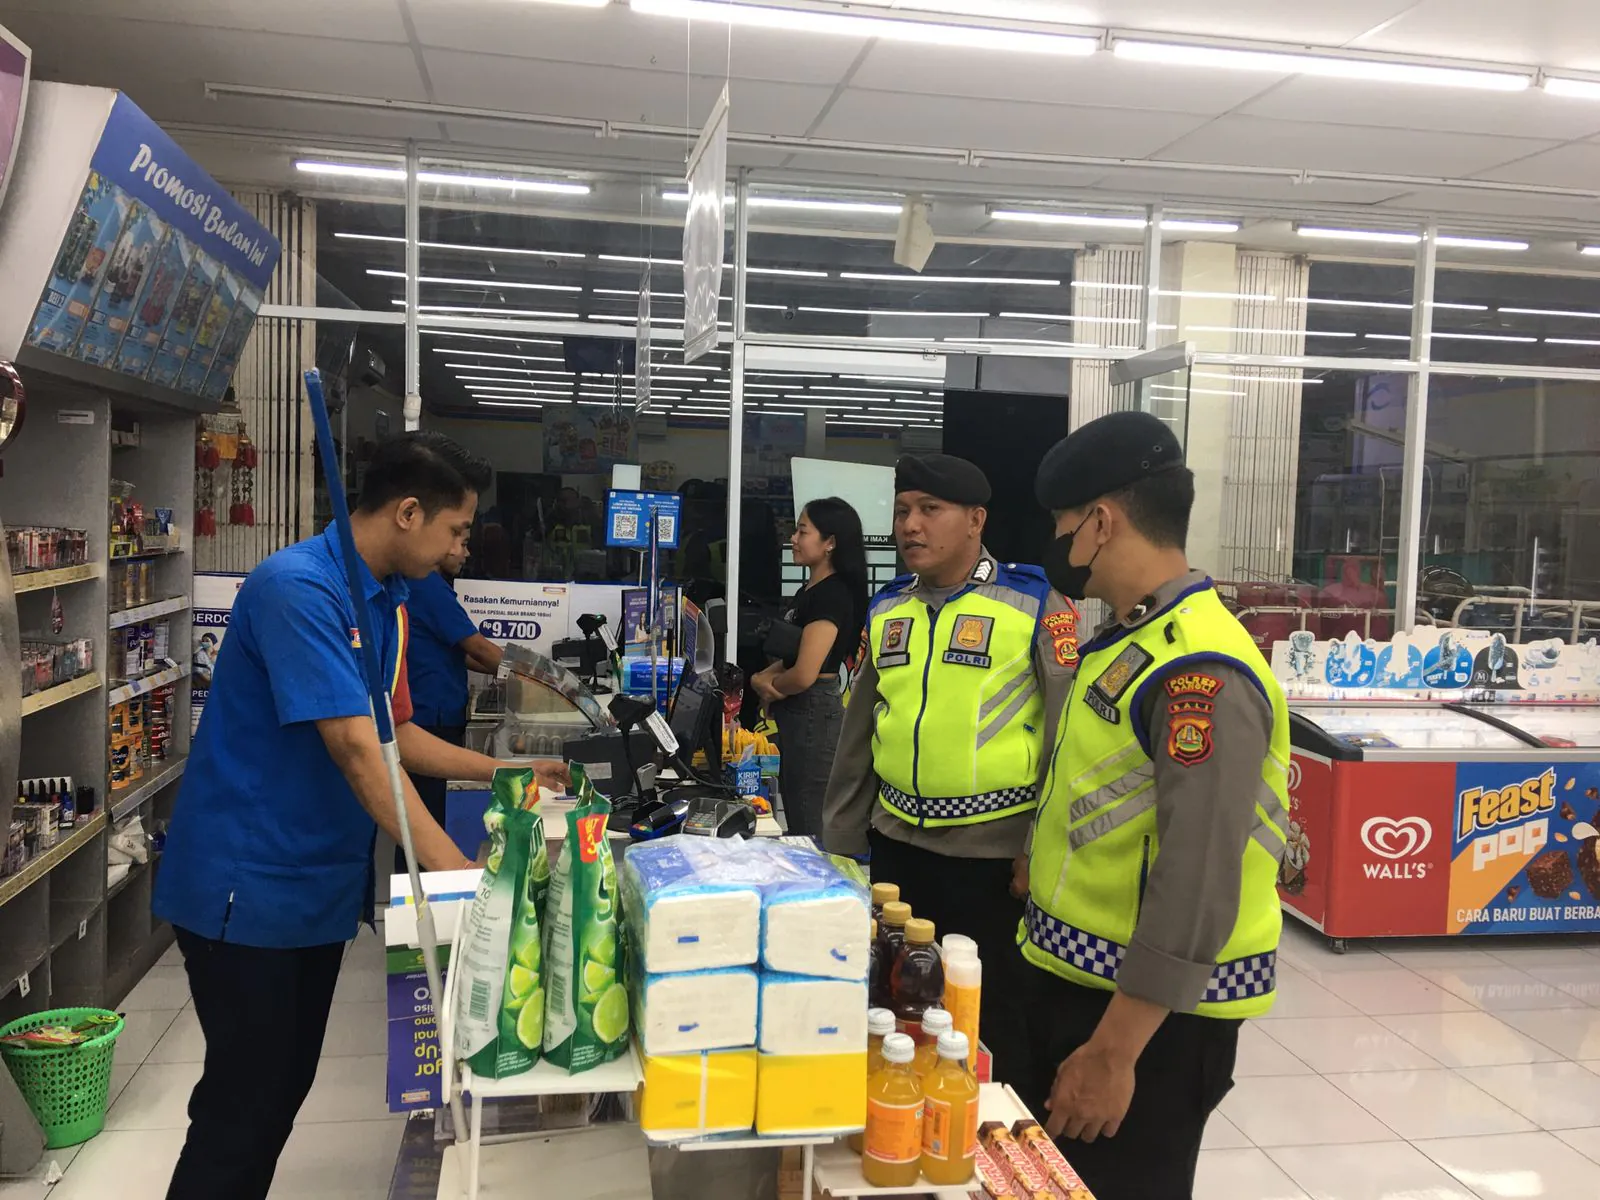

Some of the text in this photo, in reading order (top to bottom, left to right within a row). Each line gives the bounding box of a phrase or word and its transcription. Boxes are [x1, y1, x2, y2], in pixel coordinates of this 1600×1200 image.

[129, 143, 269, 268] Promosi Bulan Ini
[463, 594, 560, 608] Rasakan Kemurniannya!
[482, 621, 537, 639] Rp 9.700
[946, 652, 987, 666] POLRI
[1169, 676, 1217, 689] POLRES
[1173, 702, 1209, 711] BALI
[737, 771, 760, 780] KIRIM
[1457, 767, 1557, 842] Feast
[1363, 863, 1427, 879] WALL'S
[1456, 908, 1490, 923] CARA
[1493, 907, 1526, 922] BARU
[1529, 906, 1560, 921] BUAT
[414, 1017, 436, 1026] omo
